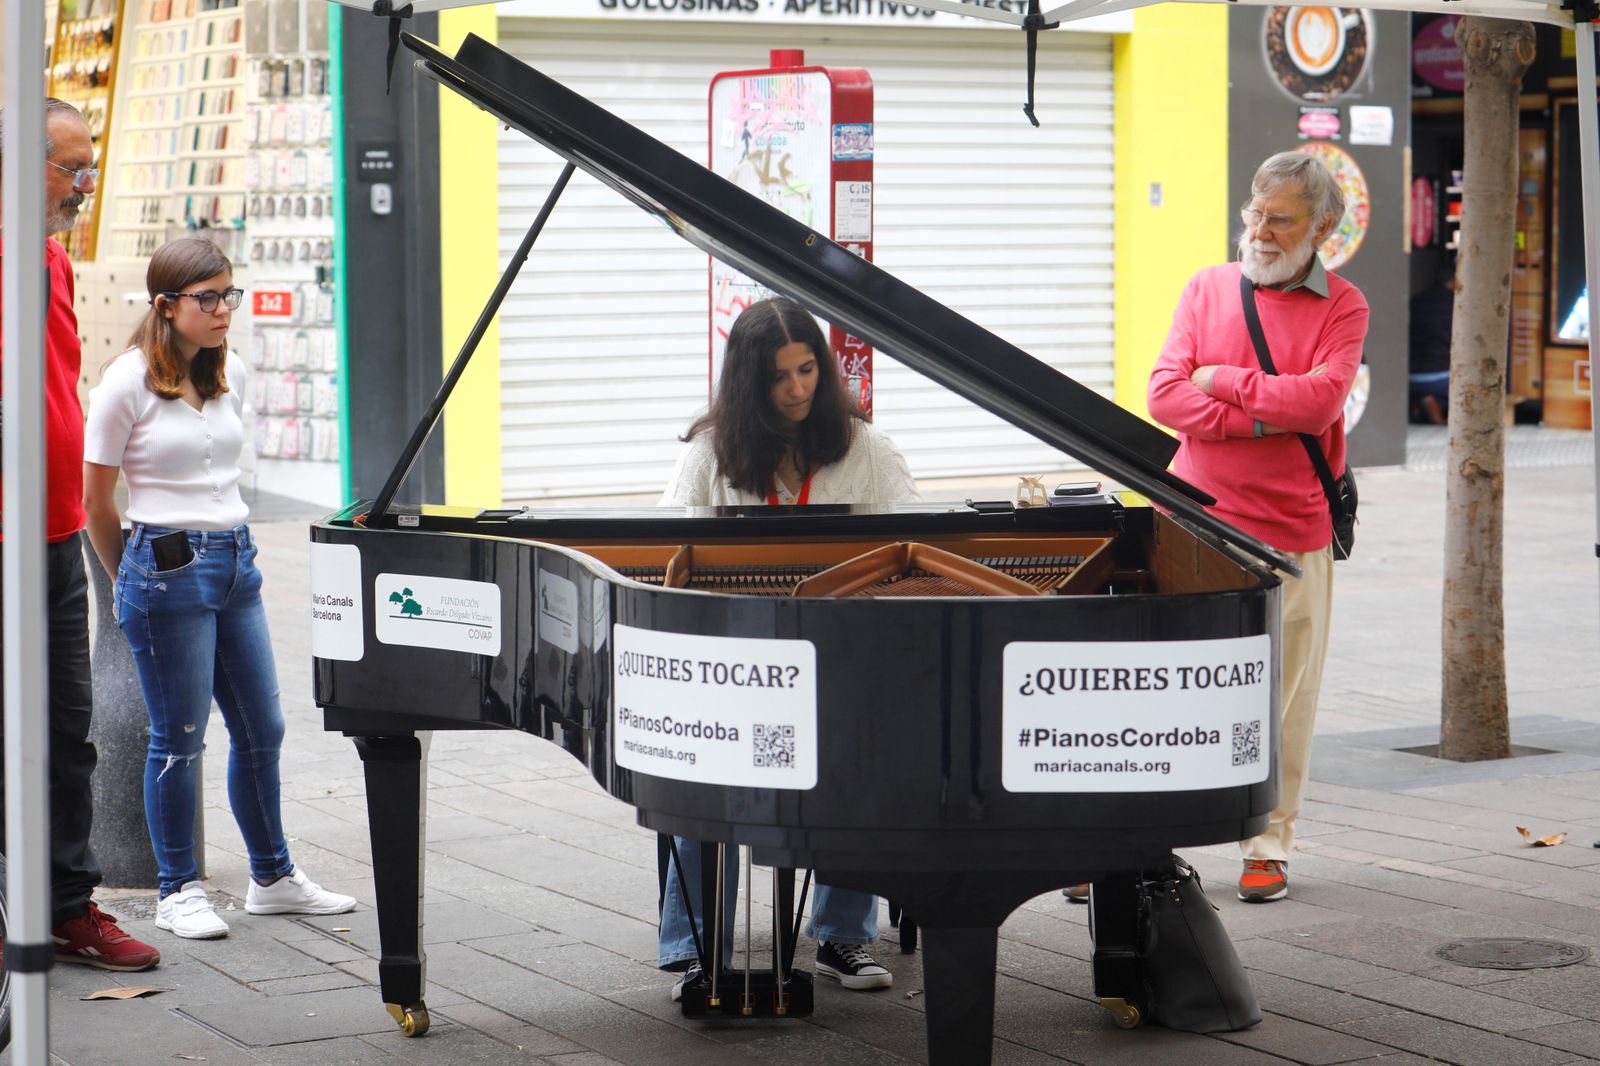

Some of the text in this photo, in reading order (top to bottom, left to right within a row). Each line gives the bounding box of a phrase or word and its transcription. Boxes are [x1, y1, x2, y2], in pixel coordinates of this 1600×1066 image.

[326, 594, 354, 607] Canals
[425, 606, 448, 617] Ricardo
[468, 629, 492, 640] COVAP
[618, 650, 800, 688] ¿QUIERES TOCAR?
[1019, 661, 1264, 696] ¿QUIERES TOCAR?
[618, 707, 740, 742] #PianosCordoba
[1018, 727, 1221, 748] #PianosCordoba
[623, 738, 696, 765] mariacanals.org
[1034, 760, 1171, 774] mariacanals.org
